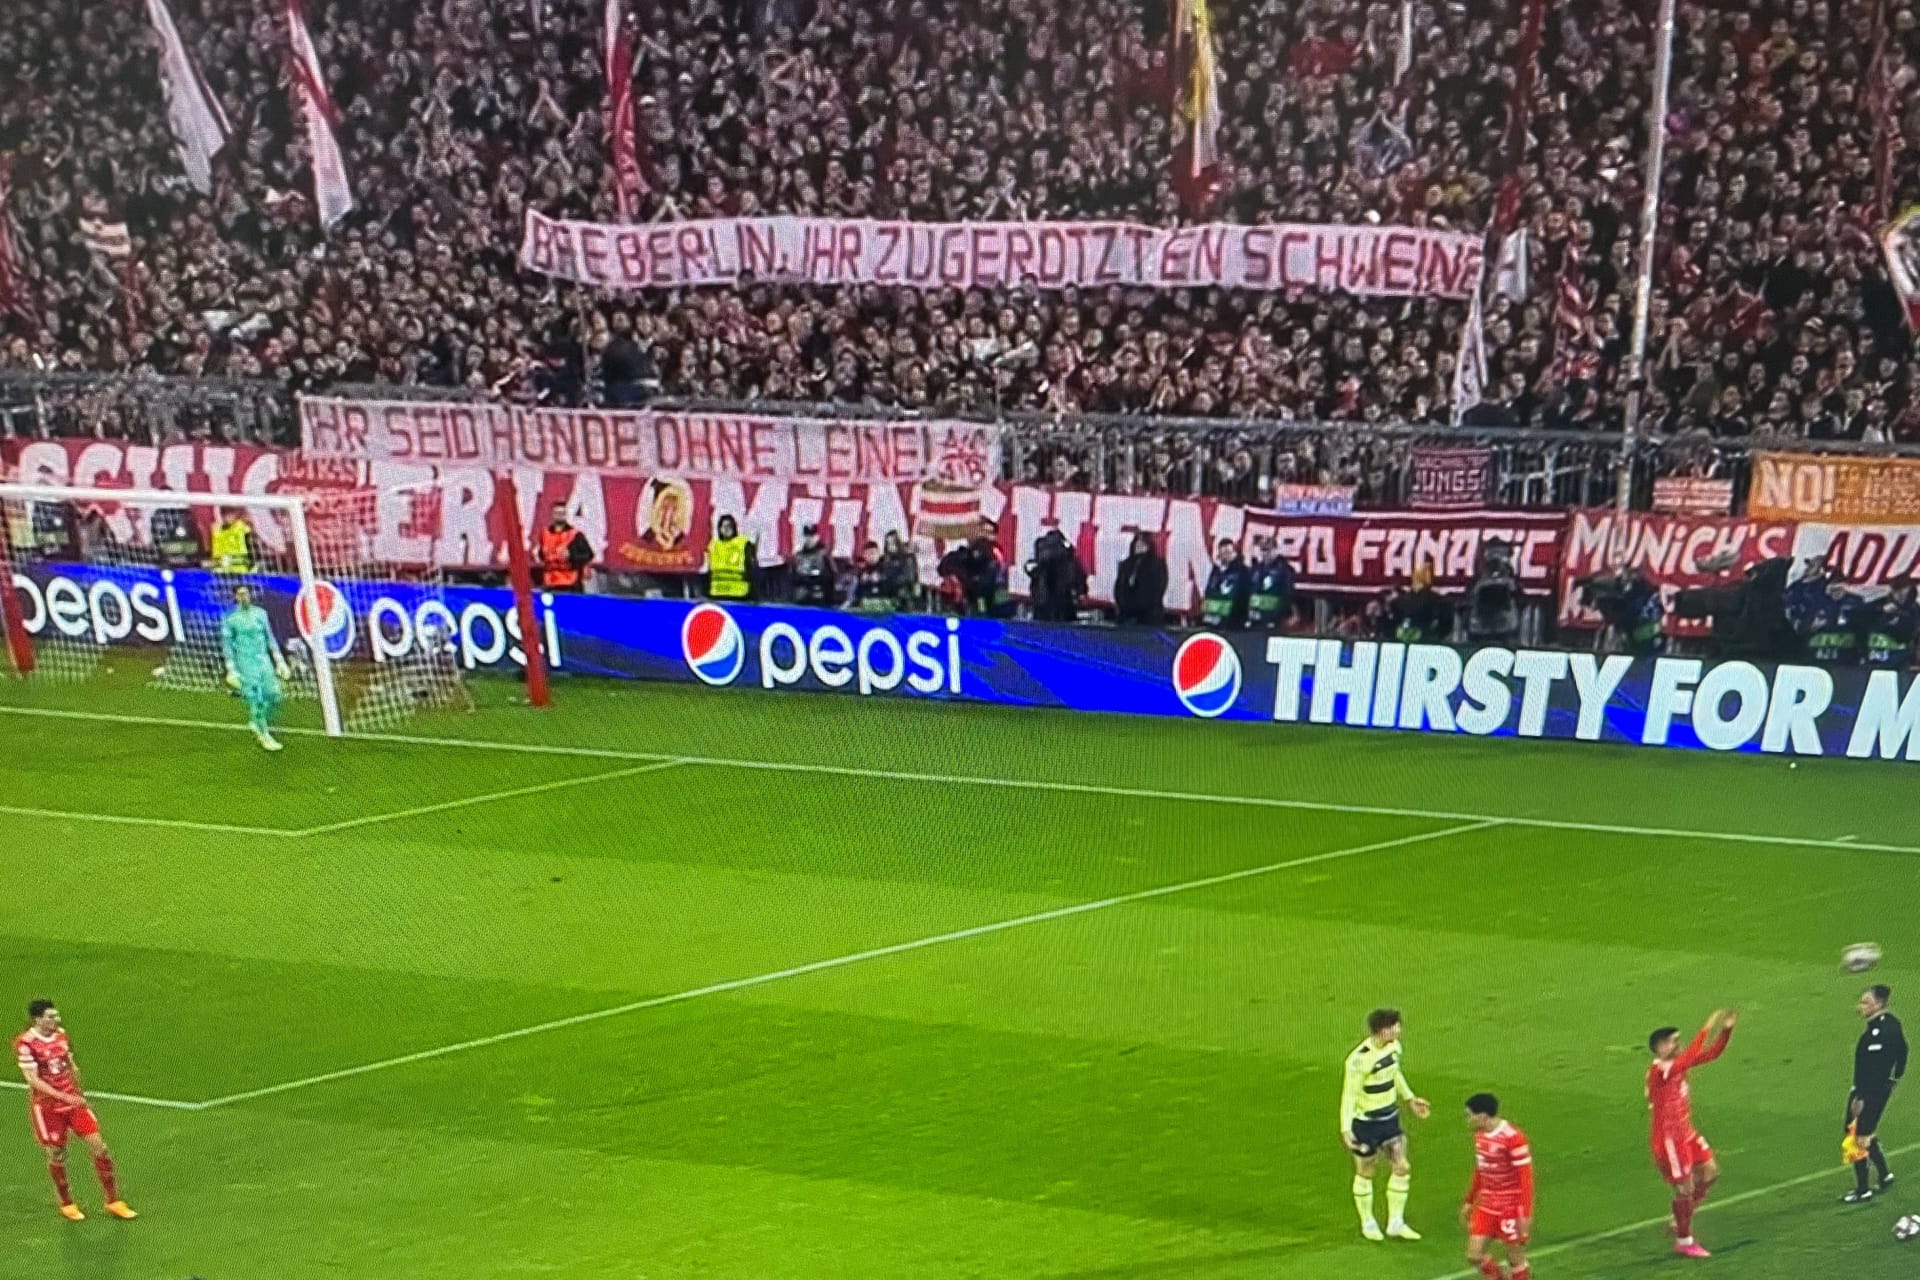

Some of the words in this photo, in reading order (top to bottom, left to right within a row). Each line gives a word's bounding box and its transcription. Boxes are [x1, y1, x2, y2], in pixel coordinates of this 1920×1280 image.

[803, 224, 861, 280] IHR
[1242, 230, 1483, 293] SCHWEINE
[384, 406, 478, 458] SEID
[655, 416, 775, 474] OHNE
[1759, 459, 1836, 514] NO!
[12, 569, 185, 644] pepsi
[760, 617, 961, 695] pepsi
[1266, 636, 1634, 741] THIRSTY
[1641, 656, 1834, 755] FOR
